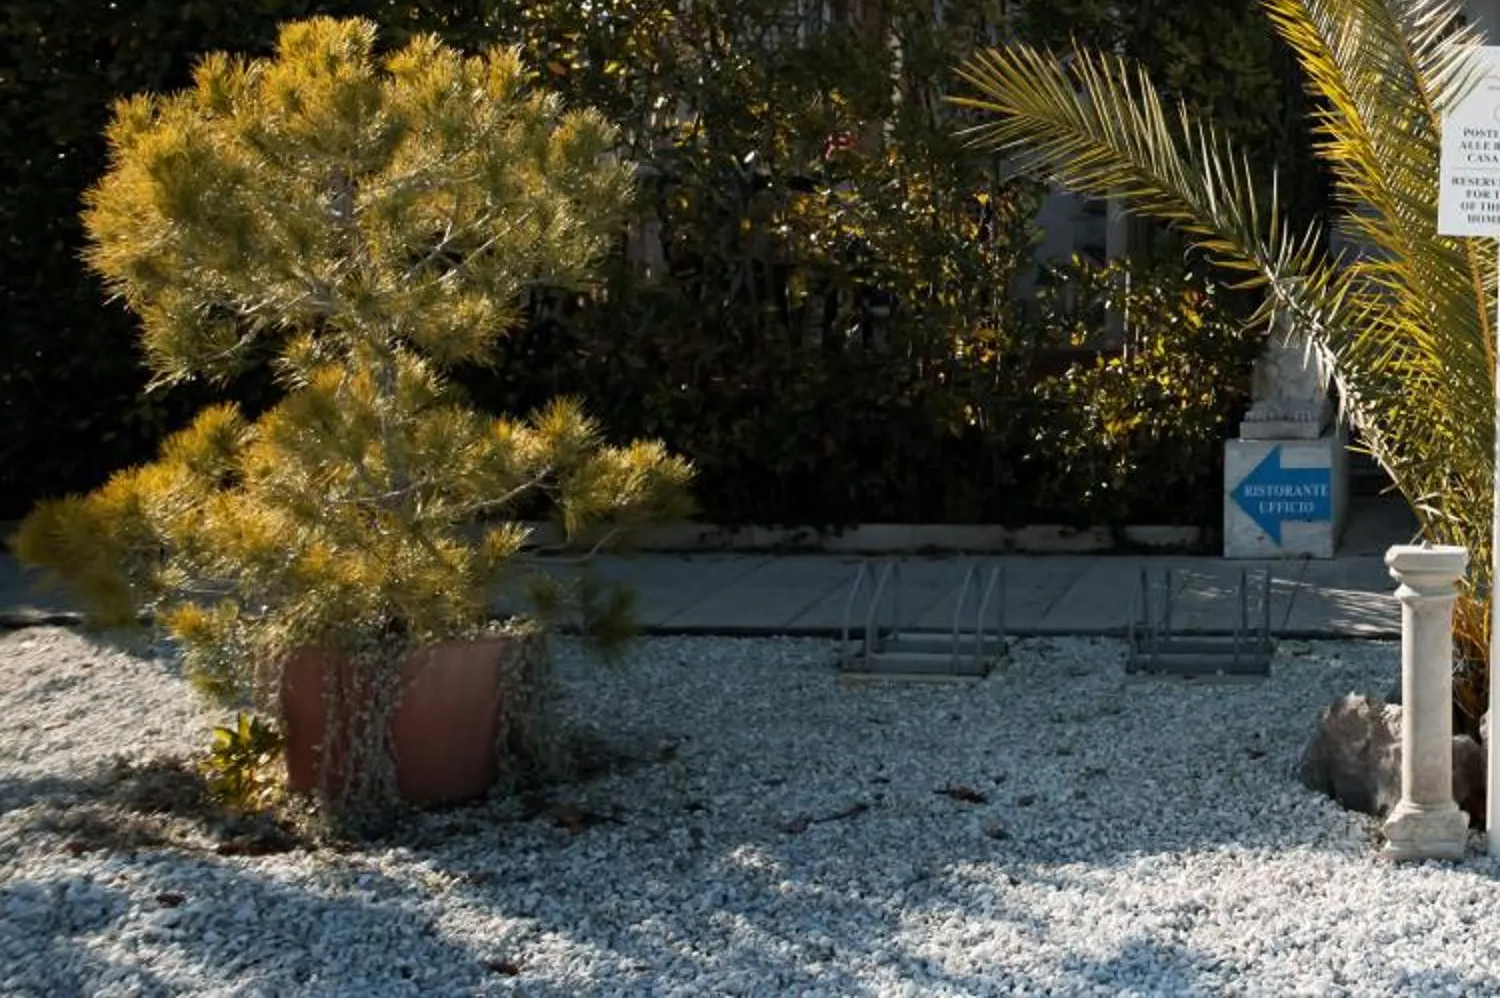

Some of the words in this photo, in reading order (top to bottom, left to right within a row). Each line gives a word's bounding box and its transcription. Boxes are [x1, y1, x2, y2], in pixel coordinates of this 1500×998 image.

[1463, 128, 1499, 139] POSTI
[1460, 140, 1491, 151] ALLE
[1467, 153, 1499, 163] CASA
[1466, 189, 1491, 199] FOR
[1460, 202, 1476, 211] OF
[1244, 484, 1328, 497] RISTORANTE
[1259, 501, 1315, 514] UFFICIO
